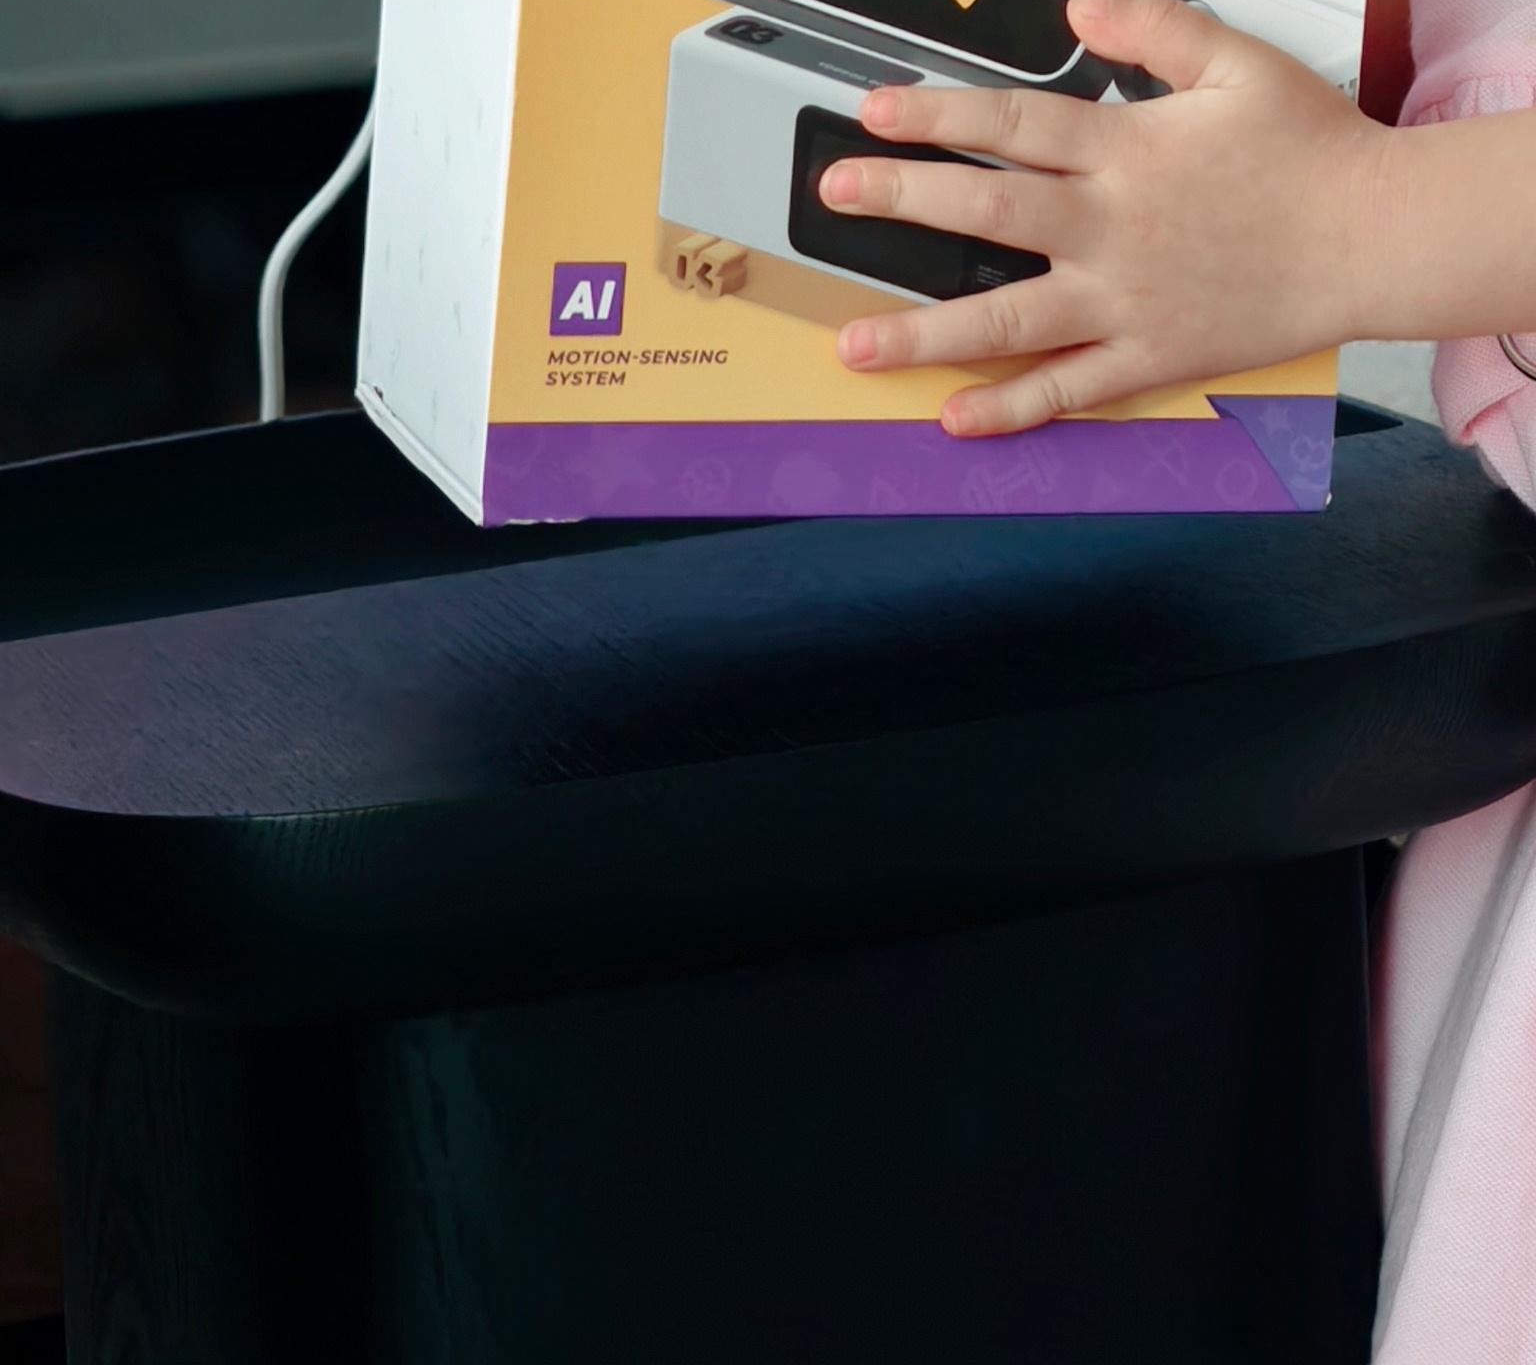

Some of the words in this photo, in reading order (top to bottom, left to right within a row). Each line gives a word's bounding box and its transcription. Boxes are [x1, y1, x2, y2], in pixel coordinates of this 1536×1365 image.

[558, 280, 617, 321] AI
[547, 349, 729, 365] MOTION-SENSING
[545, 370, 627, 386] SYSTEM
